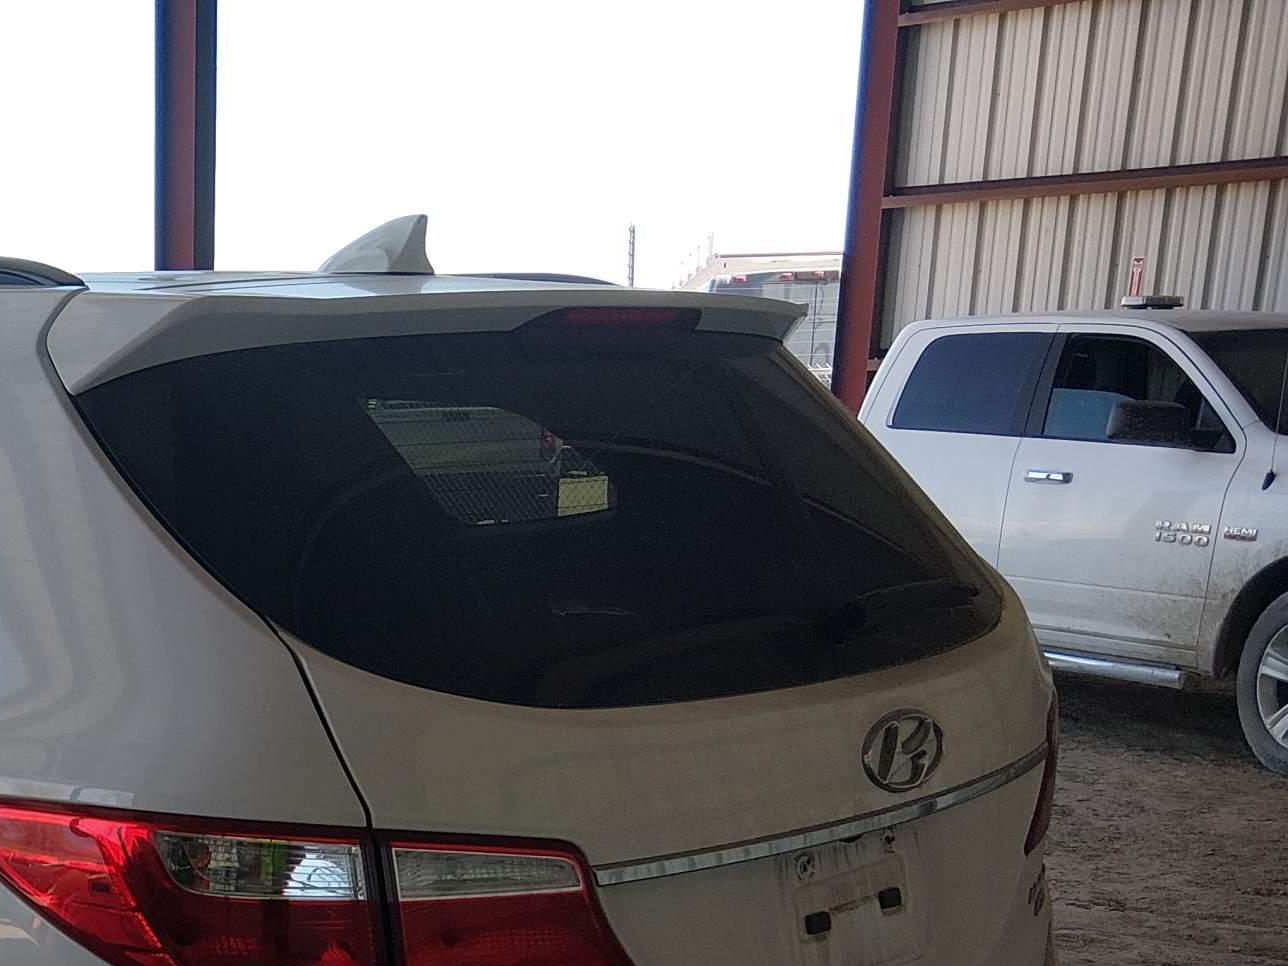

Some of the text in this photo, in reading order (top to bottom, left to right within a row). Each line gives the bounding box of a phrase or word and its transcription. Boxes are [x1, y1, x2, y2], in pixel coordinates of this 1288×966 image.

[1154, 520, 1212, 534] RAM
[1224, 527, 1258, 536] HEMI
[1154, 531, 1210, 547] 1500
